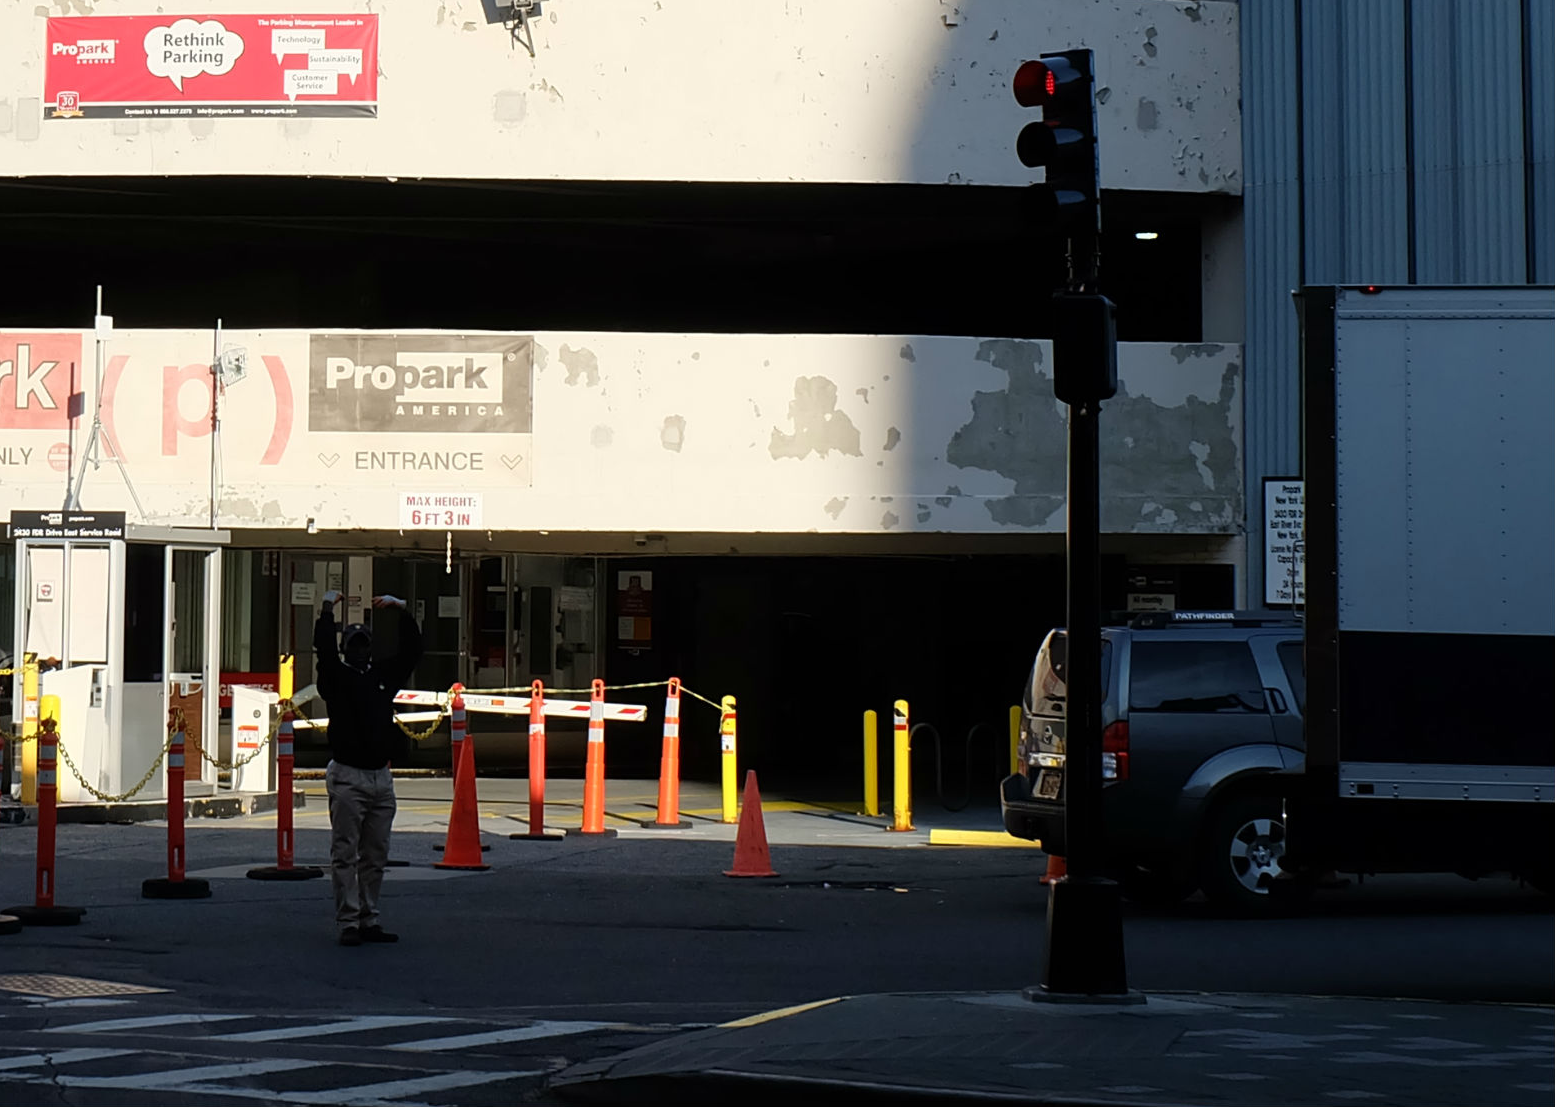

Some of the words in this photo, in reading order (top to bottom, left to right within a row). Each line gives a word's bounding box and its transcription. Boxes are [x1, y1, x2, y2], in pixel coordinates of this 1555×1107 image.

[163, 33, 225, 47] Rethink
[277, 36, 321, 45] Technology
[52, 42, 109, 56] Propark
[163, 50, 223, 66] Parking
[309, 55, 361, 64] Sustainability
[292, 74, 328, 82] Customer
[296, 82, 324, 90] Service
[62, 96, 74, 106] 30
[326, 357, 489, 396] Propark
[396, 405, 504, 416] AMERICA
[355, 452, 484, 471] ENTRANCE
[407, 496, 431, 506] MAX
[435, 496, 477, 507] HEIGHT:
[412, 510, 422, 525] 6
[425, 513, 440, 525] FT
[444, 510, 454, 526] 3
[457, 513, 470, 526] IN
[45, 528, 63, 536] Drive
[64, 528, 78, 536] East
[80, 528, 103, 536] Service
[104, 528, 122, 536] Road
[1175, 612, 1235, 620] PATHFINDER
